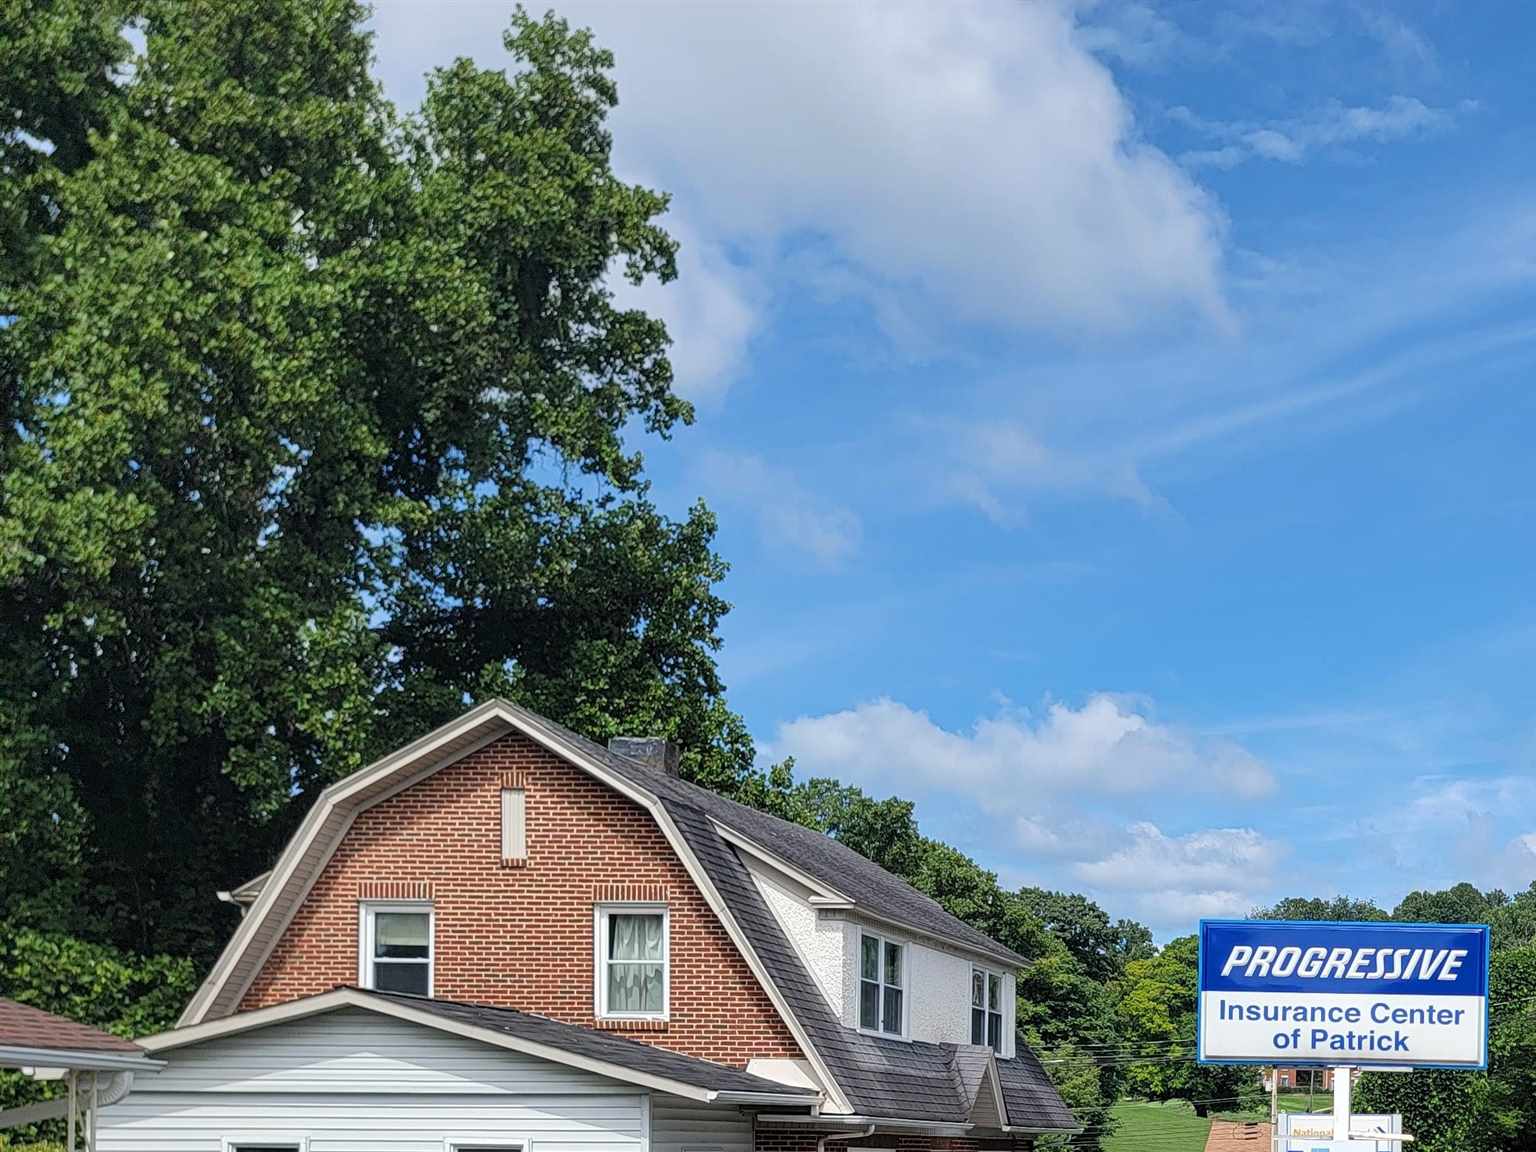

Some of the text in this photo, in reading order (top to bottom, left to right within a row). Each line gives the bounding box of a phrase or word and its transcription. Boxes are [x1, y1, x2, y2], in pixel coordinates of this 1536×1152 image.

[1220, 945, 1468, 981] PROGRESSIVE
[1219, 1000, 1465, 1025] Insurance Center
[1272, 1028, 1410, 1052] of Patrick
